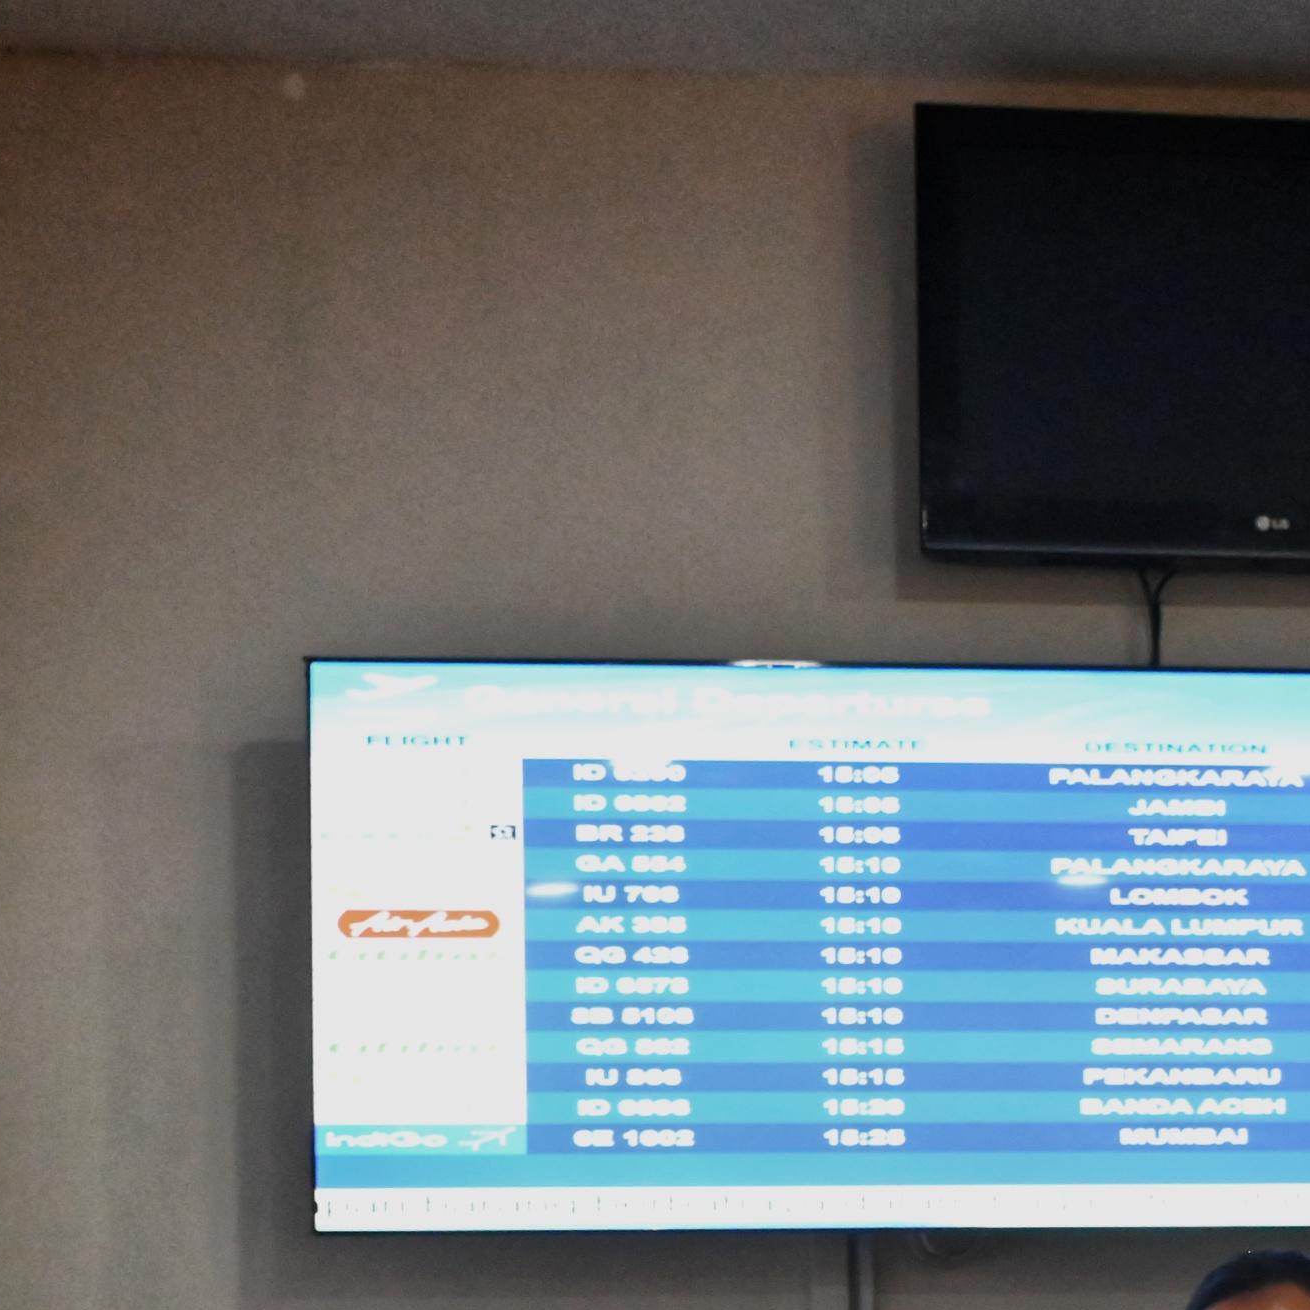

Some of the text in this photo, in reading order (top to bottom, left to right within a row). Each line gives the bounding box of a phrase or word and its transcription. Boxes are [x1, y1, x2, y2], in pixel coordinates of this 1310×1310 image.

[363, 735, 469, 748] FLIGHT
[787, 738, 925, 752] ESTIMATE
[1084, 741, 1269, 756] DESTINATION
[1128, 829, 1227, 845] TAIPEI
[584, 886, 615, 902] IU
[1110, 888, 1248, 905] LOMBOK
[577, 916, 624, 932] AK
[1056, 918, 1165, 935] KUALA
[1171, 919, 1303, 936] LUMPUR
[1091, 948, 1269, 965] MAKASSAR
[1096, 978, 1266, 995] SURABAYA
[1096, 1008, 1267, 1025] DENPASAR
[1092, 1038, 1272, 1055] SEMARANG
[1083, 1068, 1281, 1085] PEKANBARU
[326, 1131, 449, 1148] IndiGo
[1120, 1128, 1248, 1145] MUMBAI
